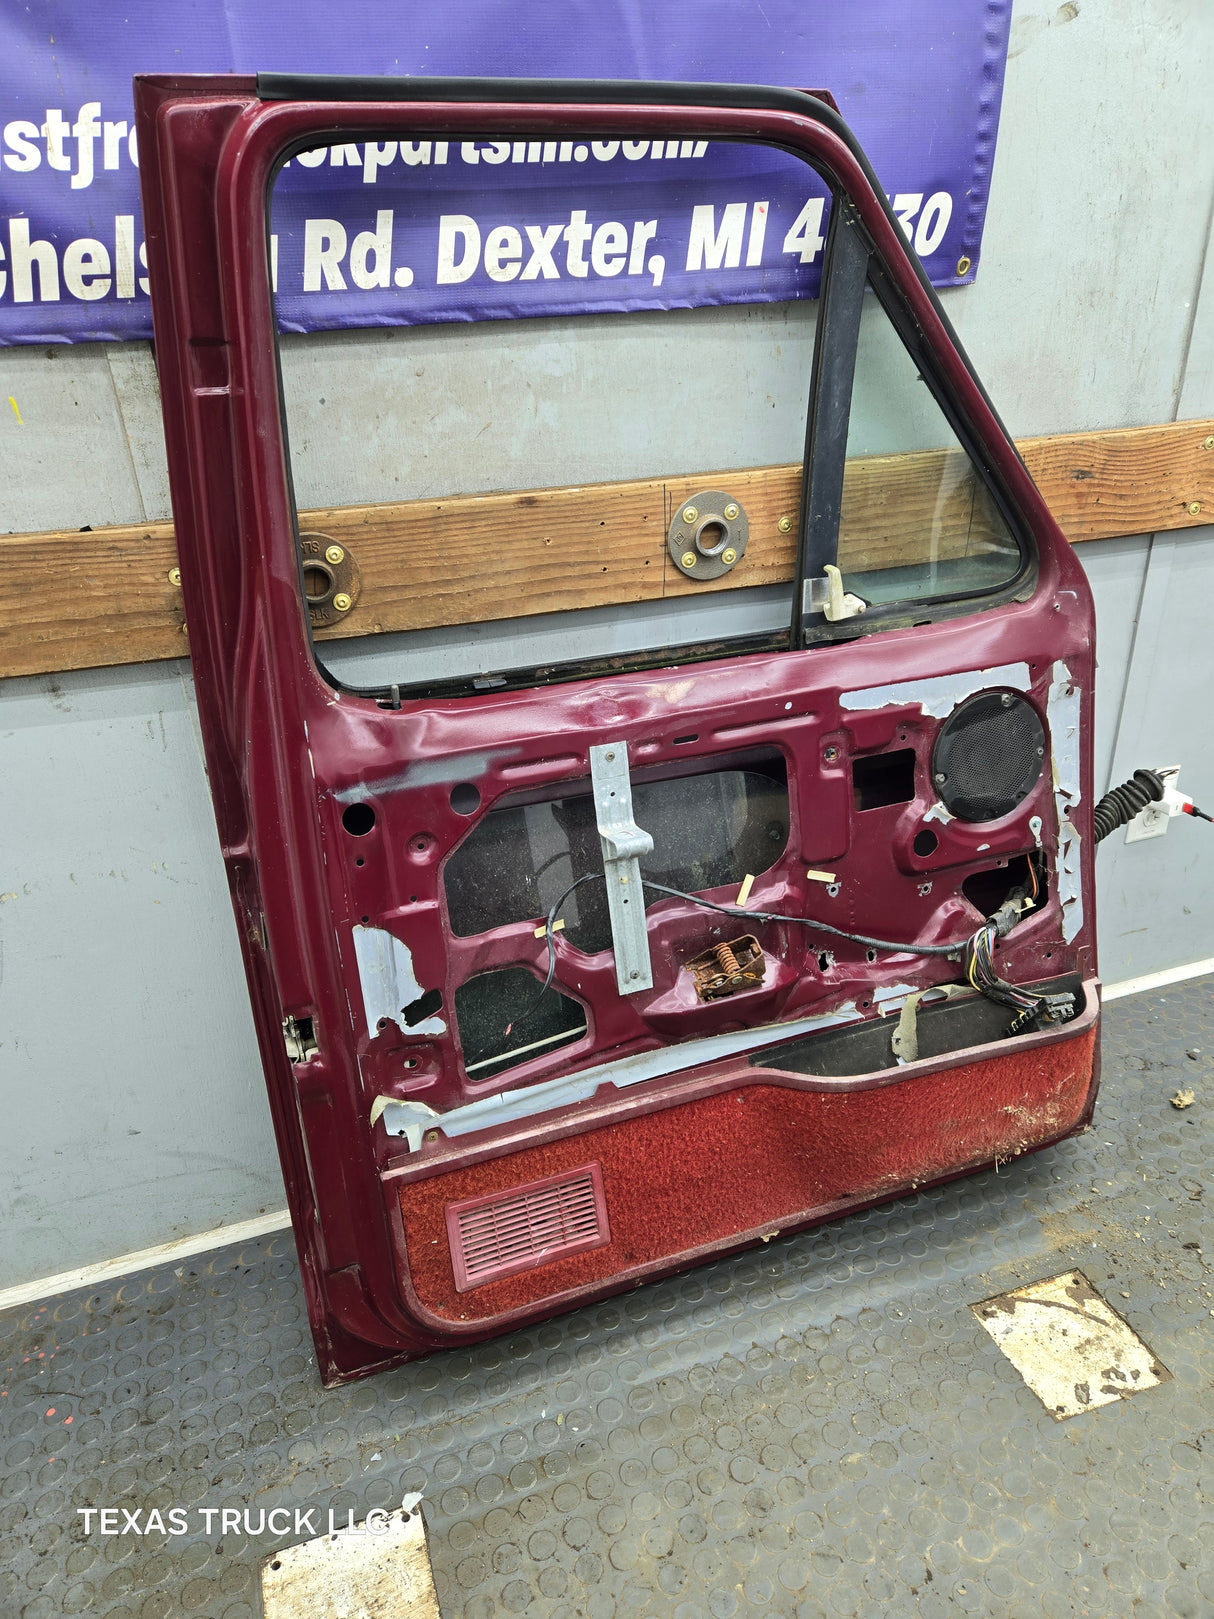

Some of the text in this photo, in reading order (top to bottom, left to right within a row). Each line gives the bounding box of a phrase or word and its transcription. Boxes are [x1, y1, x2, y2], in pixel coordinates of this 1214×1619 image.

[303, 209, 414, 292] Rd.
[436, 209, 666, 286] Dexter,
[685, 201, 769, 271] MI
